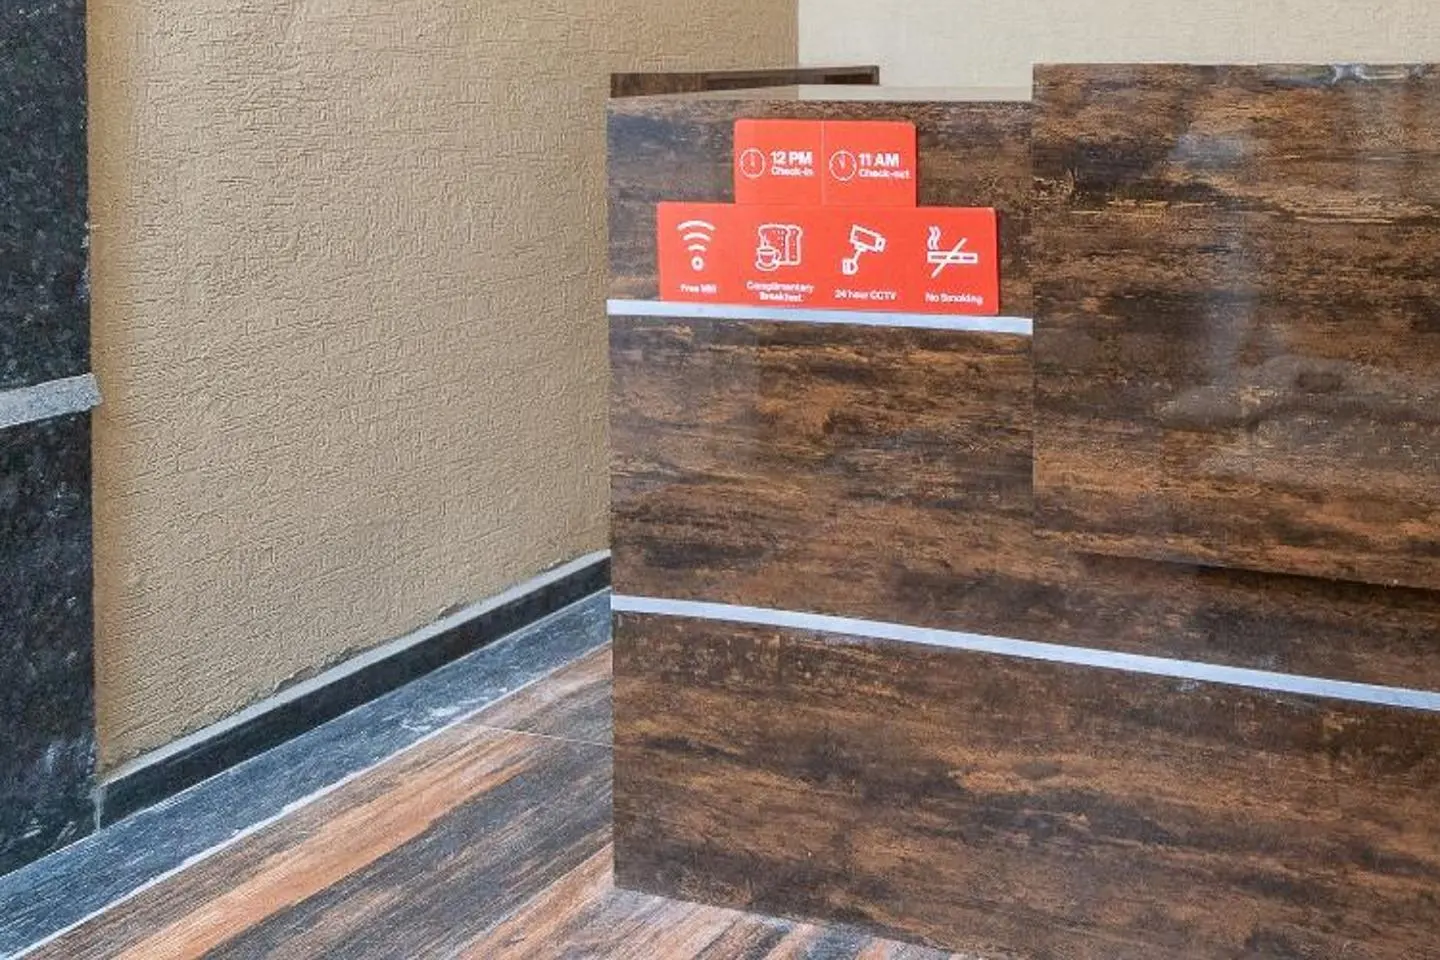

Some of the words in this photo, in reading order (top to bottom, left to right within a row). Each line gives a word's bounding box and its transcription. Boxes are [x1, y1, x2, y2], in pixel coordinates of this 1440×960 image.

[770, 151, 787, 165] 12
[788, 151, 813, 166] PM
[858, 153, 871, 166] 11
[873, 153, 900, 168] AM
[771, 166, 814, 177] Check-in
[859, 168, 911, 179] Check-out
[924, 292, 939, 302] No
[941, 292, 983, 305] Smoking
